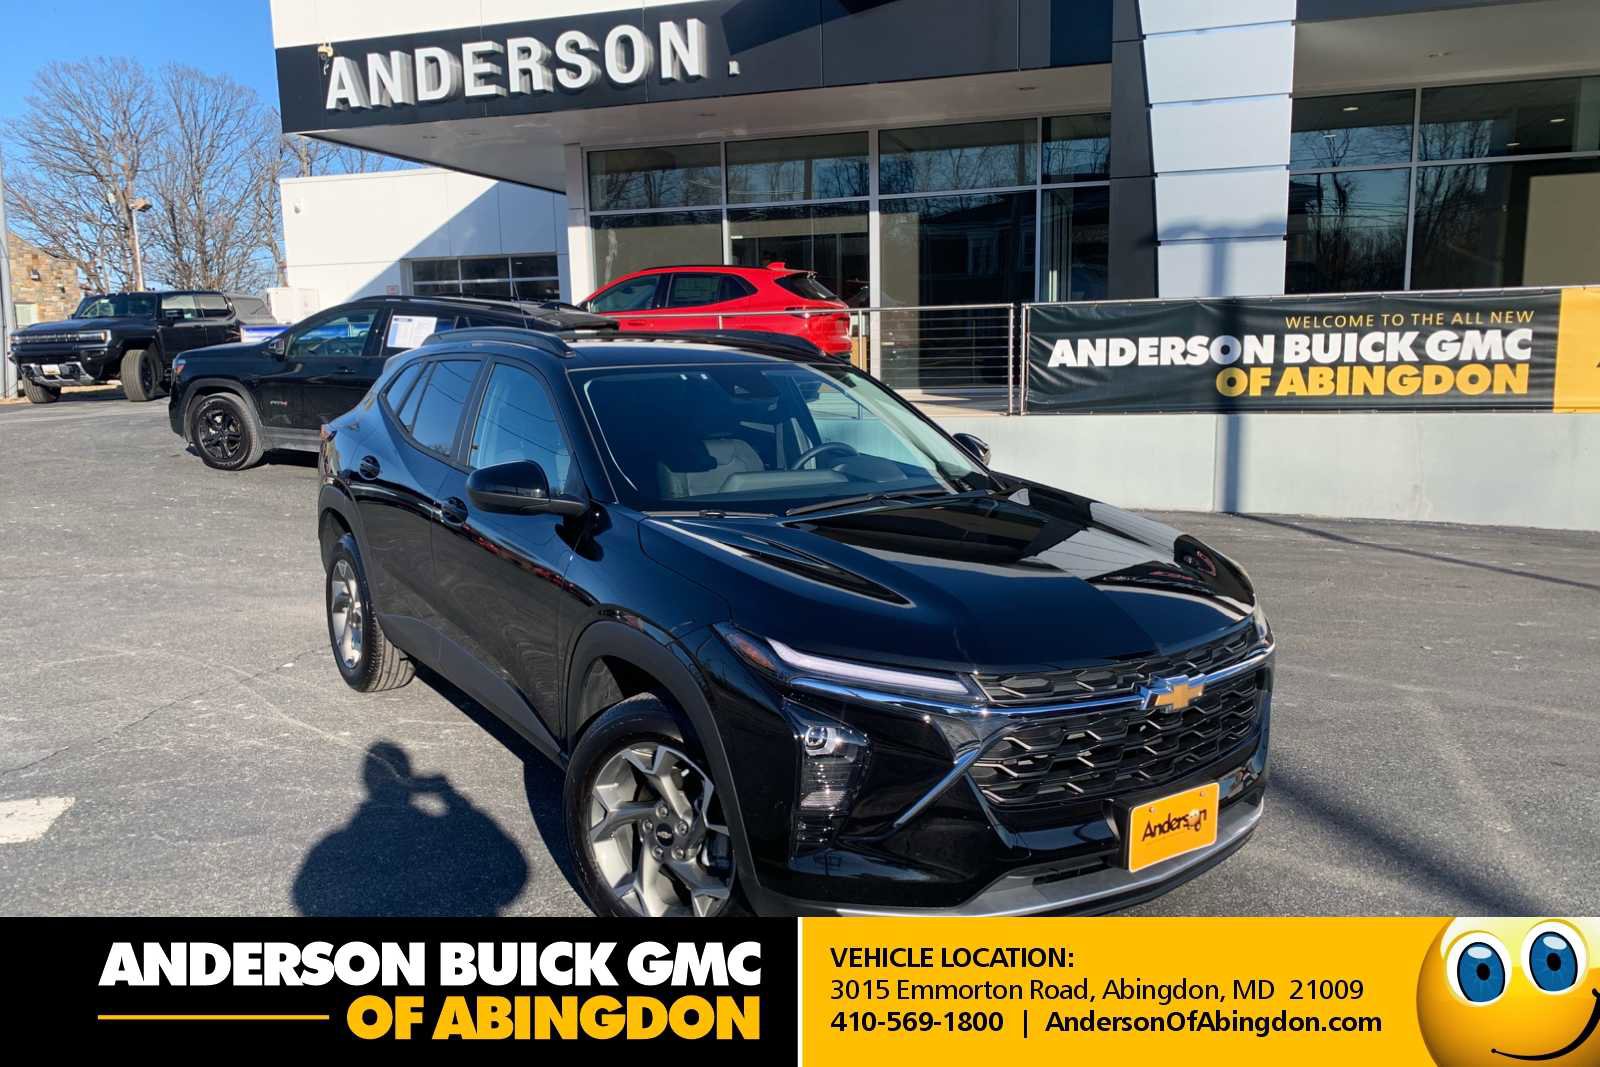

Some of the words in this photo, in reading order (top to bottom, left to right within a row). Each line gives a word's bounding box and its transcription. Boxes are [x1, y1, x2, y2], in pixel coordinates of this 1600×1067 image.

[325, 18, 706, 110] ANDERSON
[1285, 315, 1375, 330] WELCOME
[1382, 313, 1405, 327] TO
[1411, 312, 1445, 327] THE
[1451, 311, 1484, 326] ALL
[1490, 310, 1536, 325] NEW
[1047, 334, 1275, 368] ANDERSON
[1283, 331, 1420, 364] BUICK
[1424, 328, 1533, 362] GMC
[1216, 366, 1272, 397] OF
[1274, 363, 1530, 397] ABINGDON
